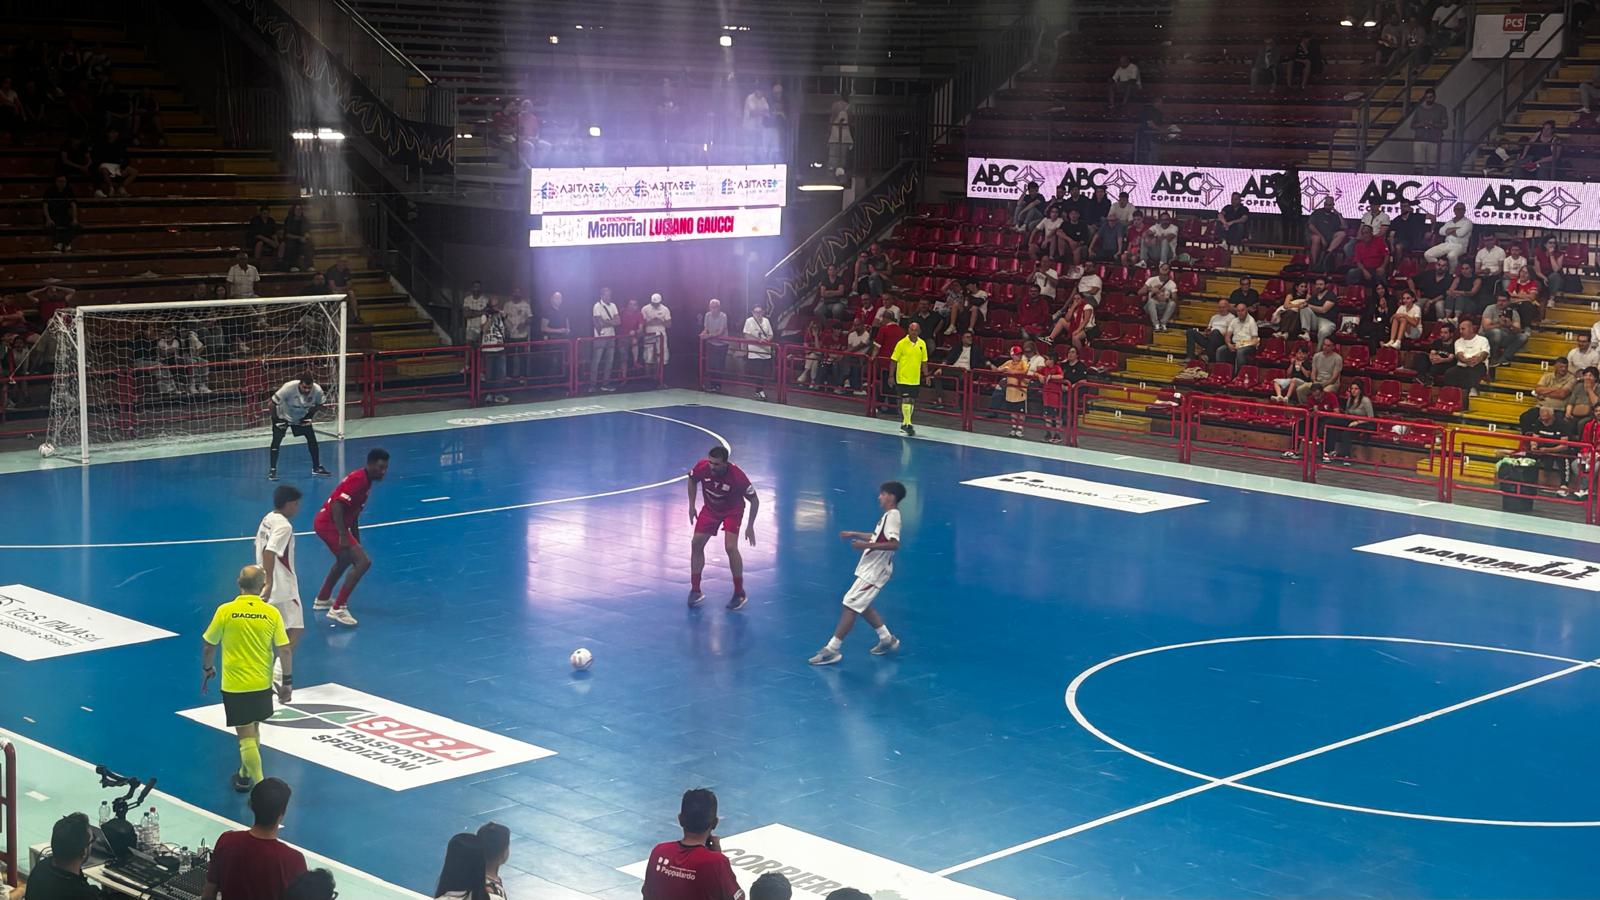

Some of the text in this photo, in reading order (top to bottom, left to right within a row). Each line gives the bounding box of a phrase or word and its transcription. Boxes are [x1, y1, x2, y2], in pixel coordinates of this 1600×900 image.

[1505, 18, 1524, 28] PCS
[971, 164, 1019, 187] ABC
[1060, 168, 1110, 191] ABC
[1151, 171, 1204, 195] ABC
[971, 186, 1018, 194] COPERTURE
[1359, 180, 1422, 205] ABC
[1475, 184, 1543, 212] ABC
[587, 218, 646, 239] Memorial
[697, 215, 734, 234] GAUCCI
[1474, 211, 1541, 221] COPERTURE
[231, 612, 268, 620] DIADORA
[337, 730, 443, 766] TRASPORTI
[356, 720, 484, 759] SUSA
[312, 734, 422, 771] SPEDIZIONI
[661, 865, 696, 880] Pappalardo
[722, 848, 843, 897] CORRIER
